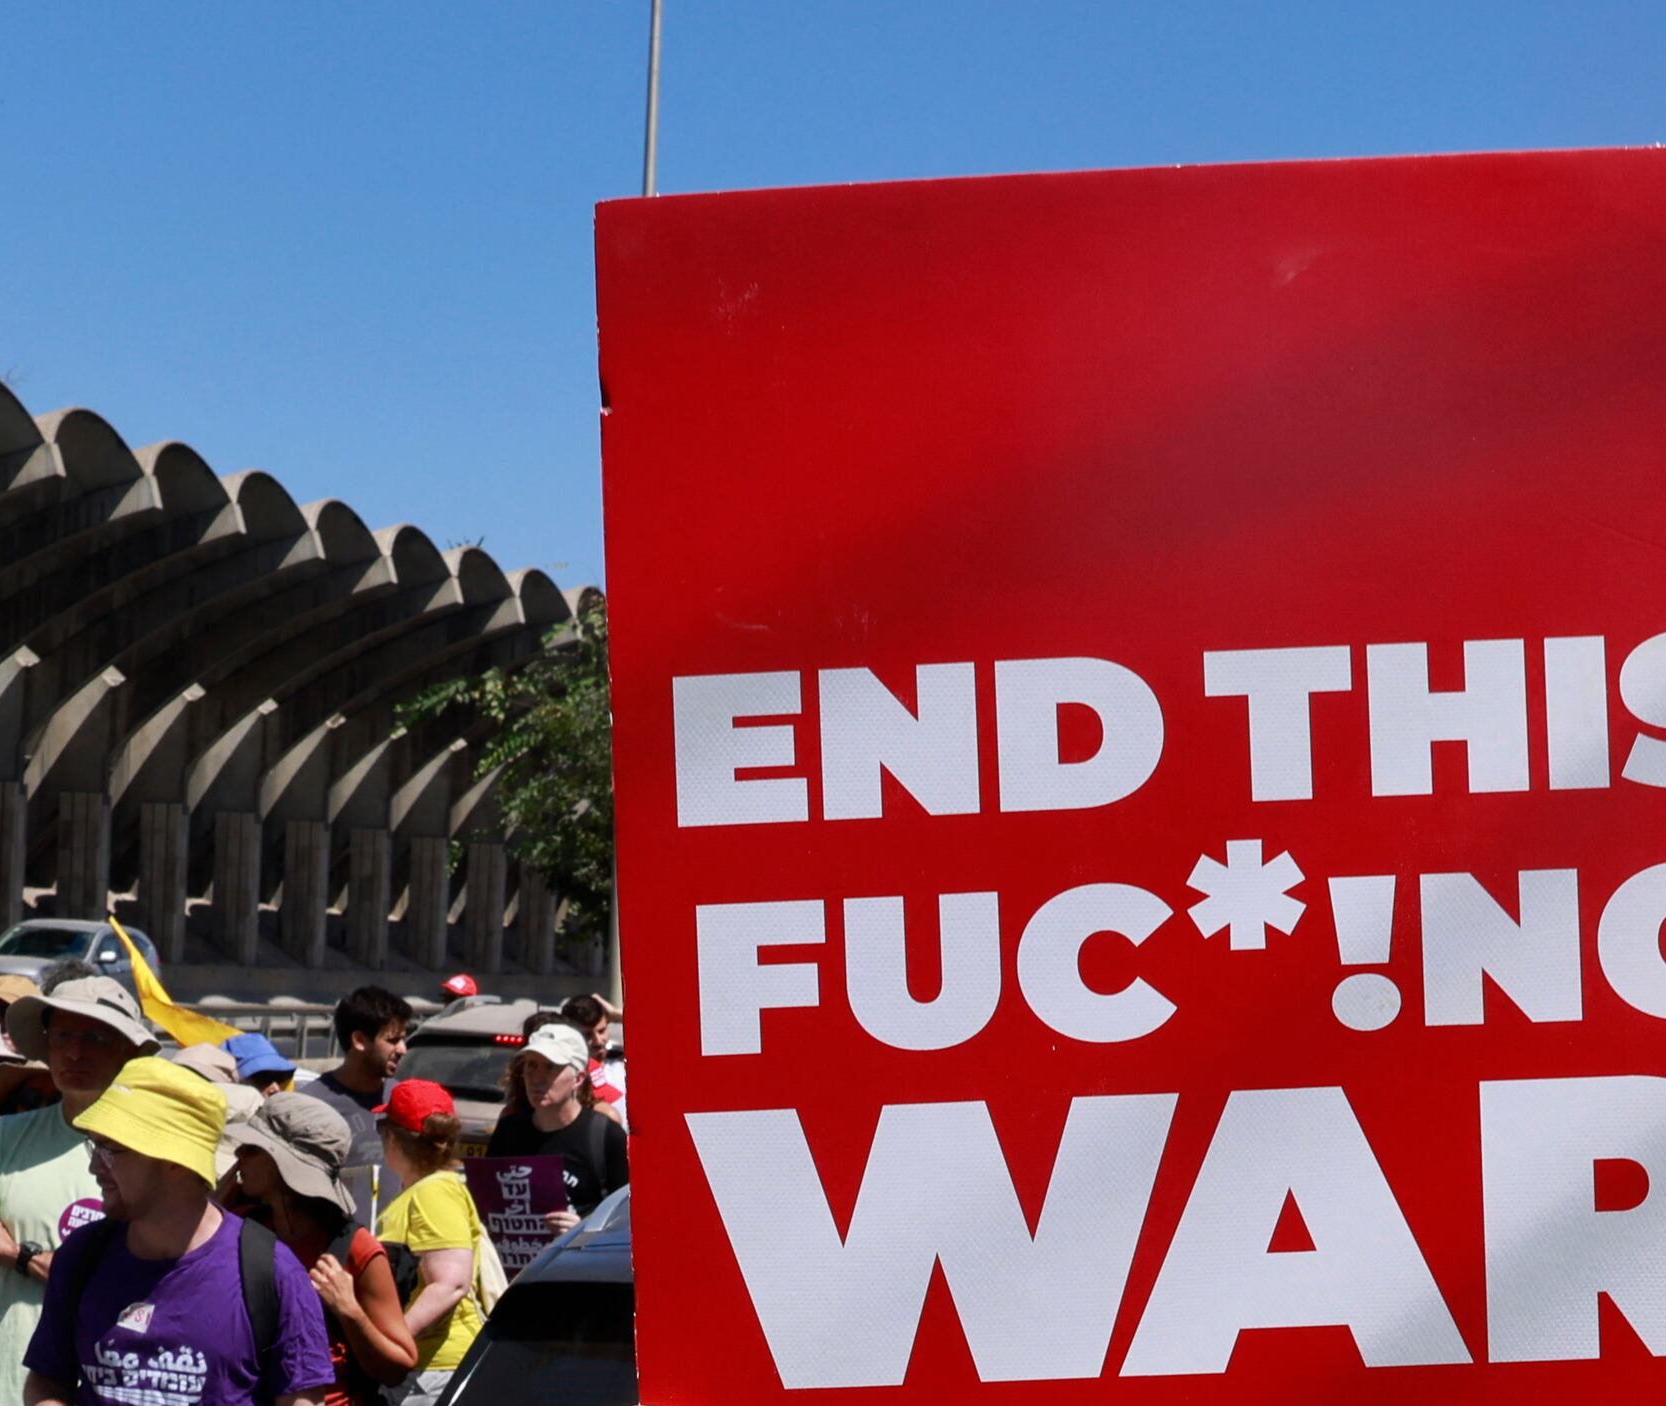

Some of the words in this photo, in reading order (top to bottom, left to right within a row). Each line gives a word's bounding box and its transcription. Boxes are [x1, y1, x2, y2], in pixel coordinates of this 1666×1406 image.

[673, 657, 1164, 827] END
[503, 1182, 528, 1196] עד
[147, 1345, 208, 1374] نقف
[122, 1369, 206, 1394] עומדים
